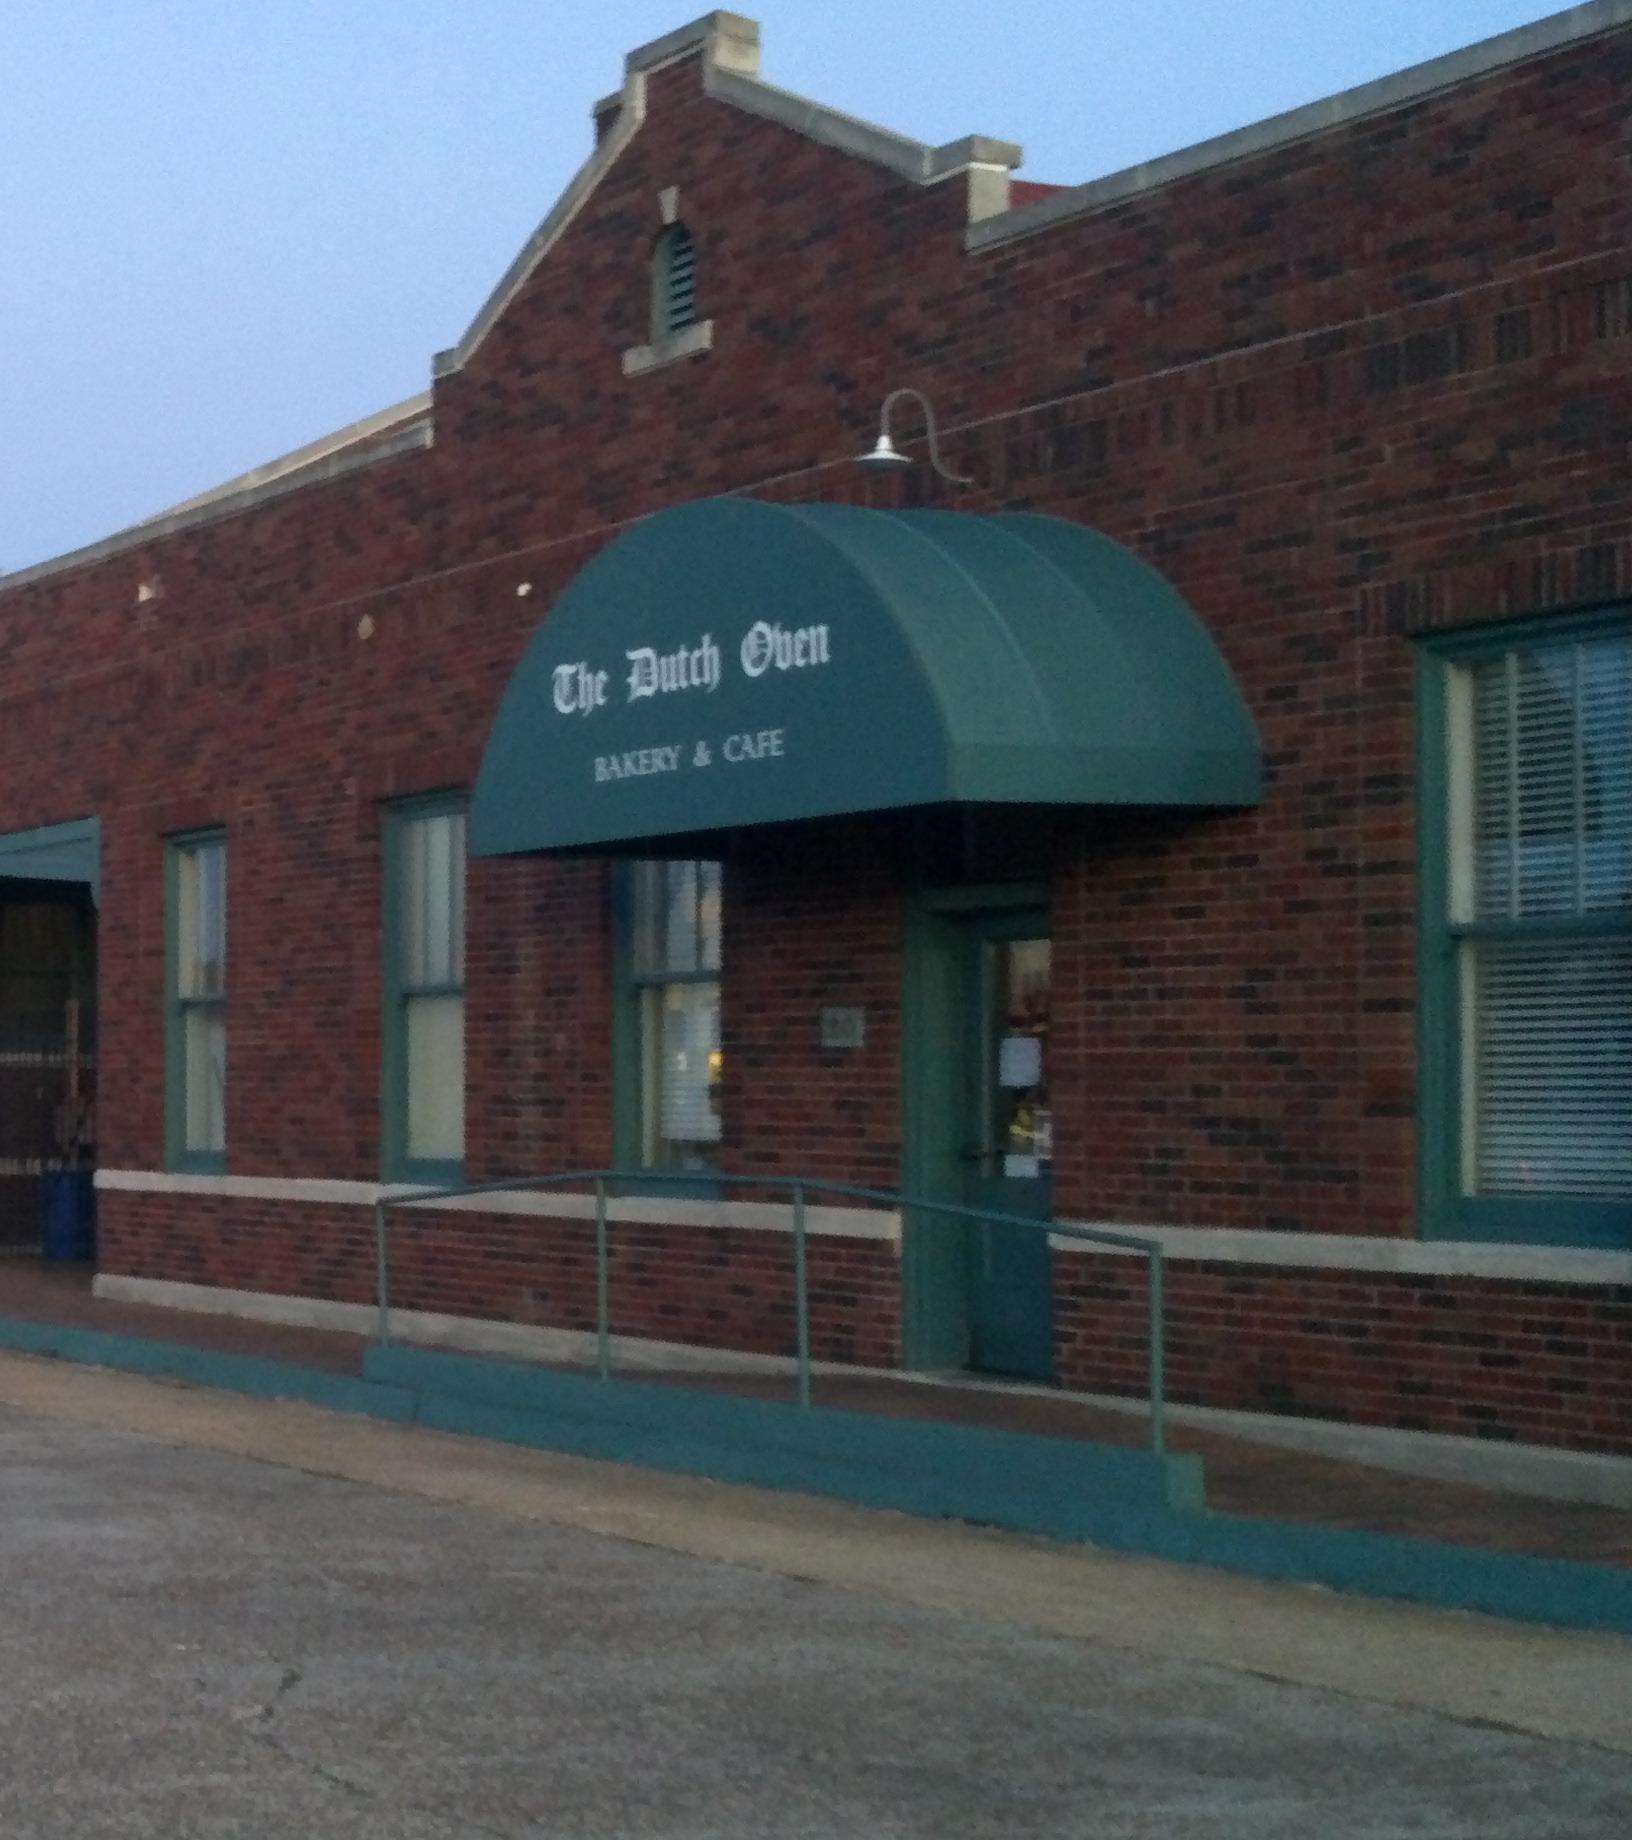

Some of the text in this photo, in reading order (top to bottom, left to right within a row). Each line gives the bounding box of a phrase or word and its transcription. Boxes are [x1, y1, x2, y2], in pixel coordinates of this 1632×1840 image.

[552, 620, 830, 716] The Dutch Oven
[593, 729, 786, 783] BAKERY & CAFE
